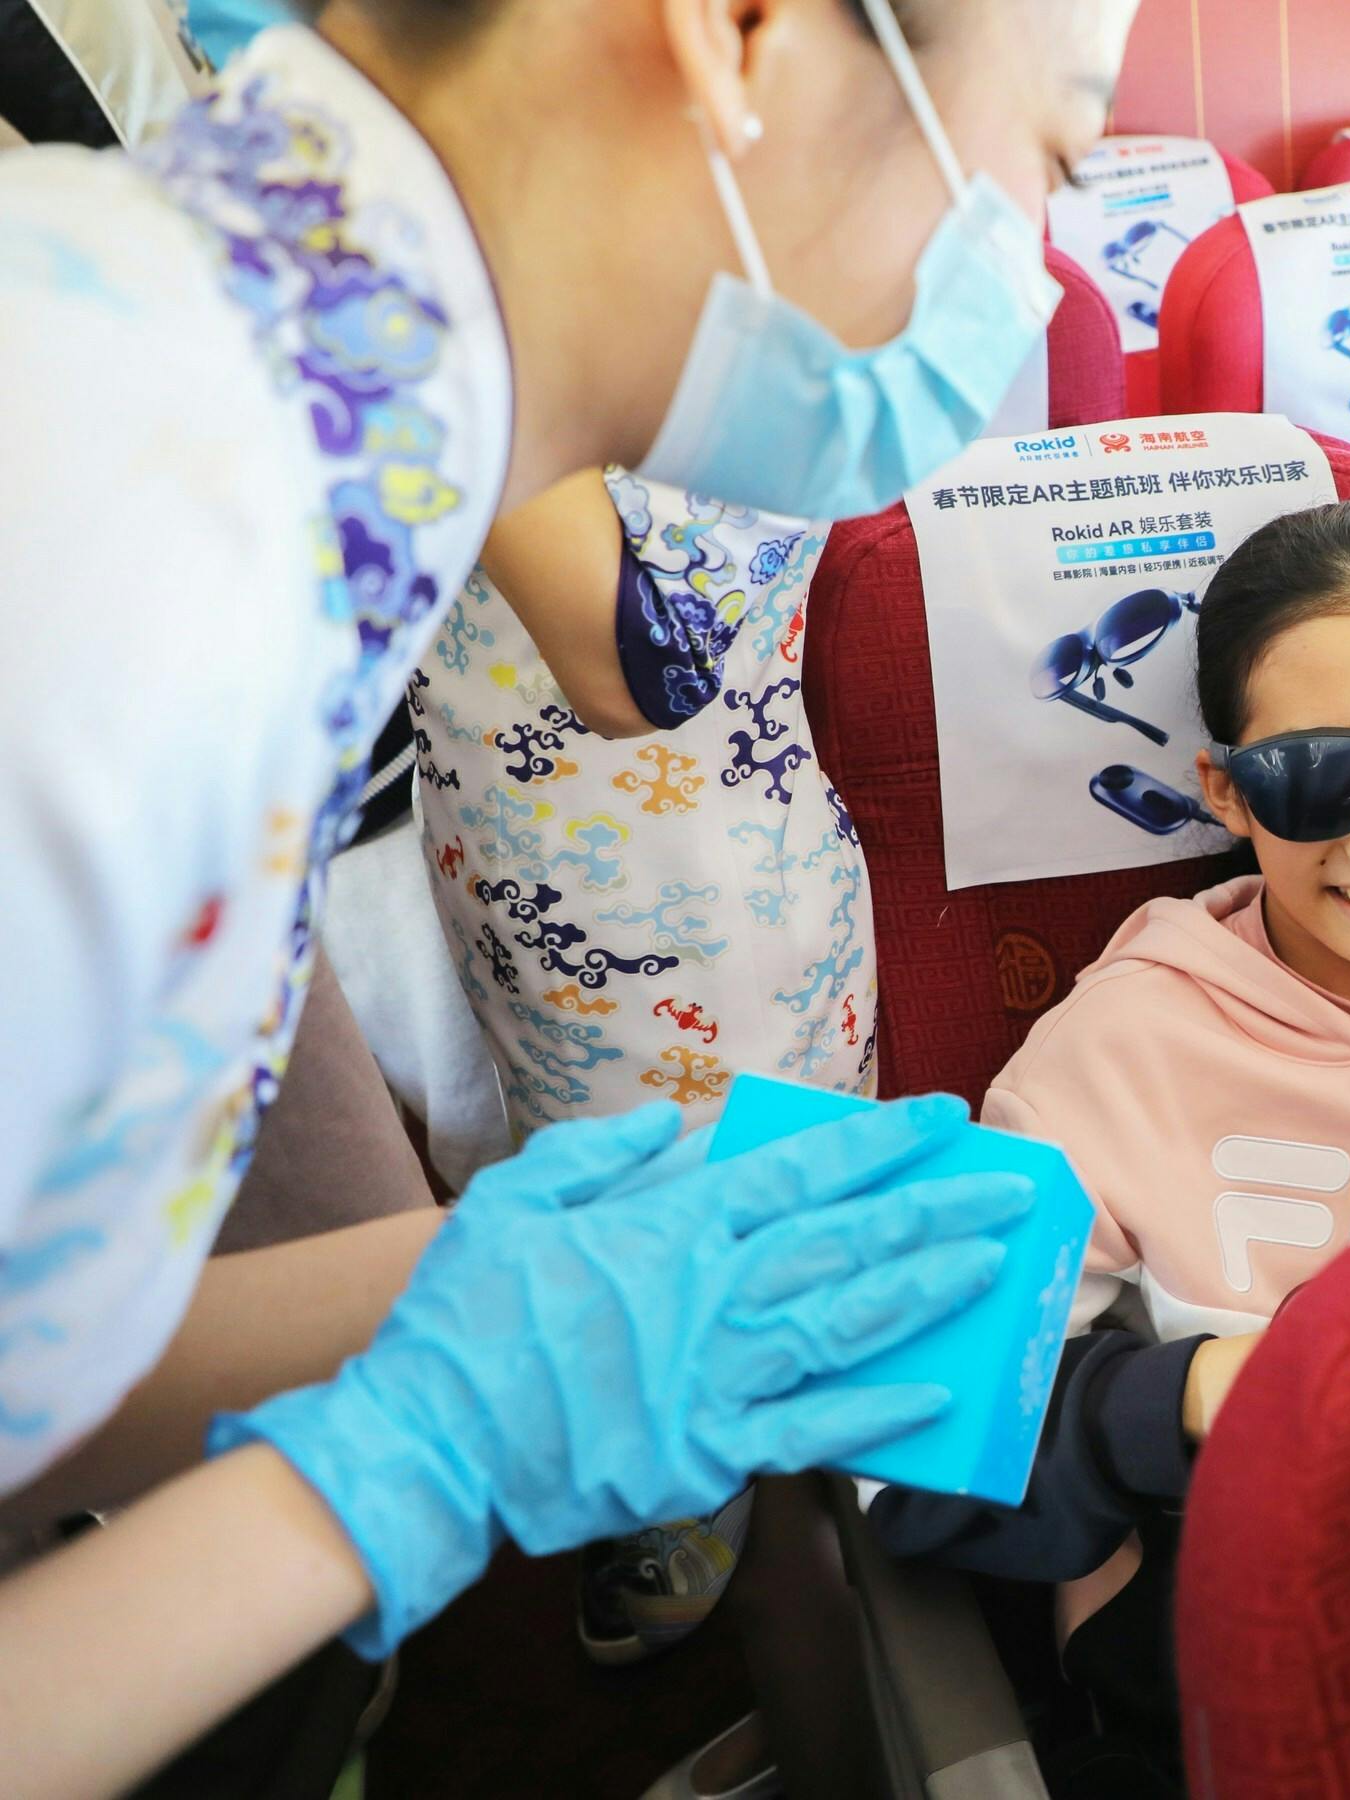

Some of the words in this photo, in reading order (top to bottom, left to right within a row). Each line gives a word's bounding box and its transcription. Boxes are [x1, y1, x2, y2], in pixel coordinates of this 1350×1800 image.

[1014, 436, 1076, 453] Rokid
[1139, 430, 1207, 444] 海南航空
[932, 466, 1163, 511] 春节限定AR主题航班
[1168, 459, 1309, 494] 伴你欢乐归家
[1051, 525, 1104, 542] Rokid
[1108, 520, 1135, 536] AR
[1139, 511, 1214, 535] 娱乐套装
